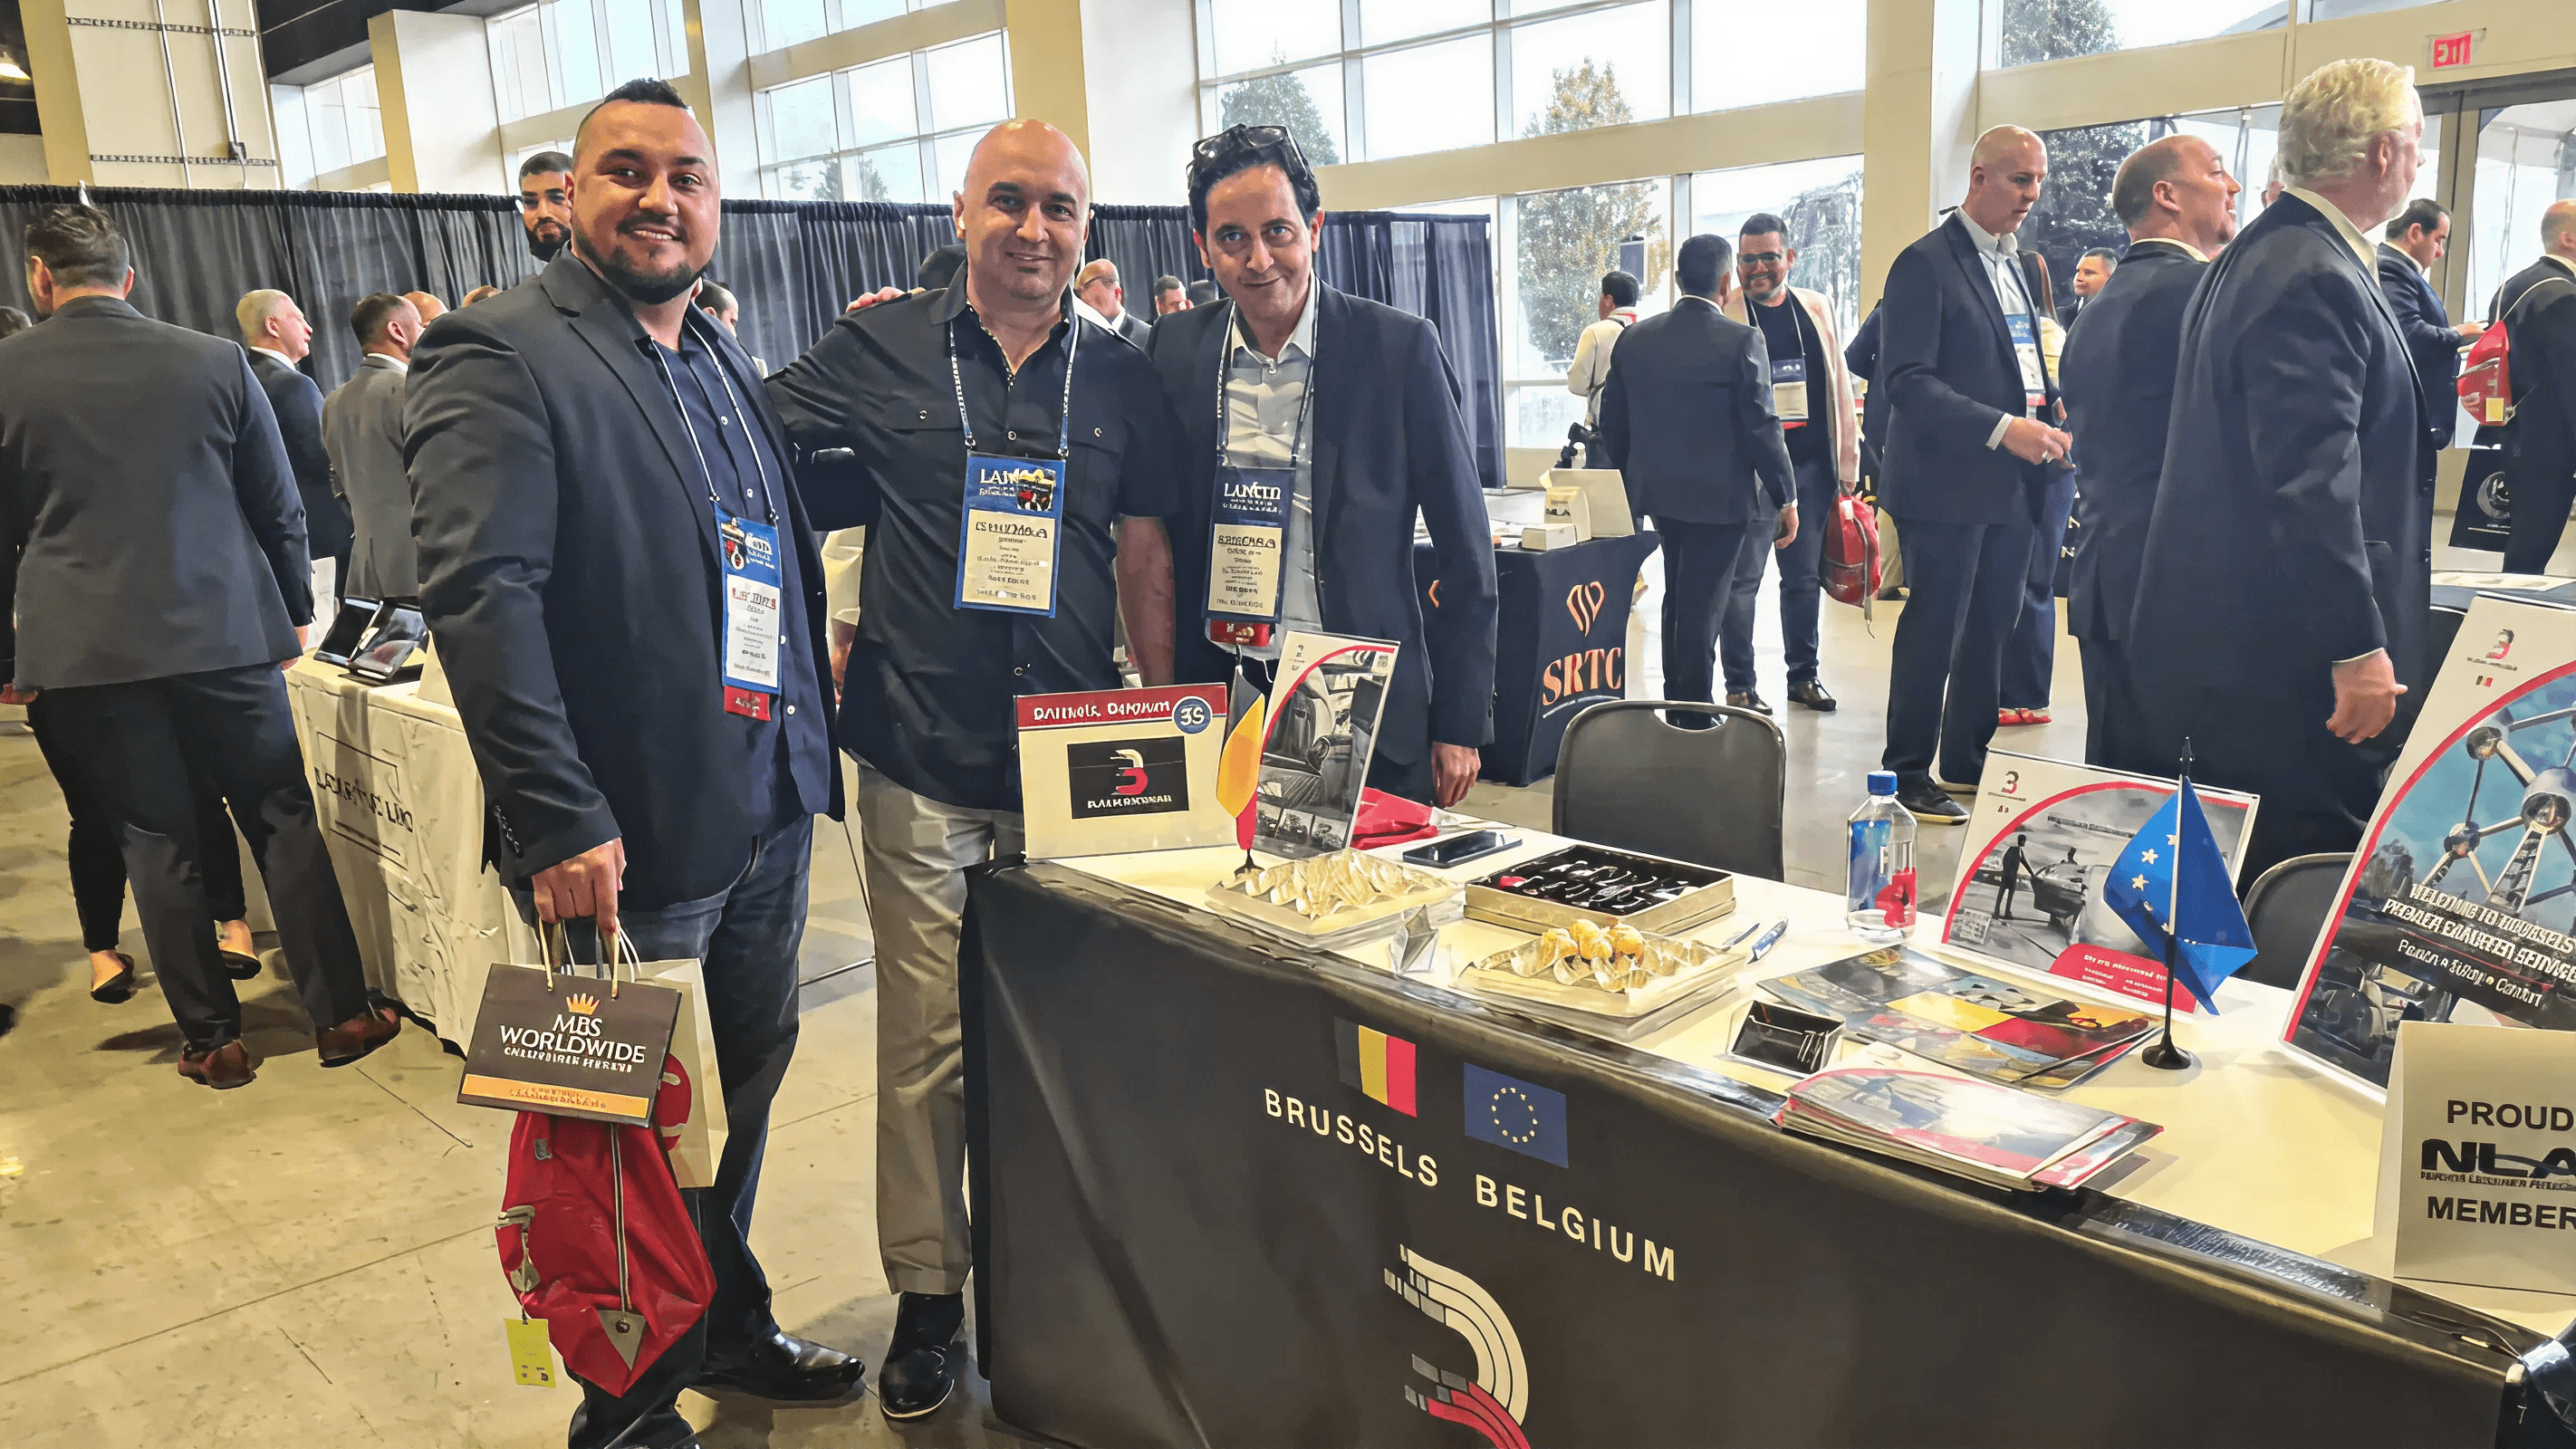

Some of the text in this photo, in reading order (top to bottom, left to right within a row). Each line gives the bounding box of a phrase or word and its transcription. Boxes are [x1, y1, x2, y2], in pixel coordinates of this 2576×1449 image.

[1543, 647, 1621, 706] SRTC
[500, 1024, 647, 1063] WORLDWIDE
[552, 1013, 603, 1038] MBS
[2446, 1099, 2574, 1132] PROUD
[1264, 1088, 1676, 1281] BRUSSELS BELGIUM
[2427, 1195, 2576, 1230] MEMBER
